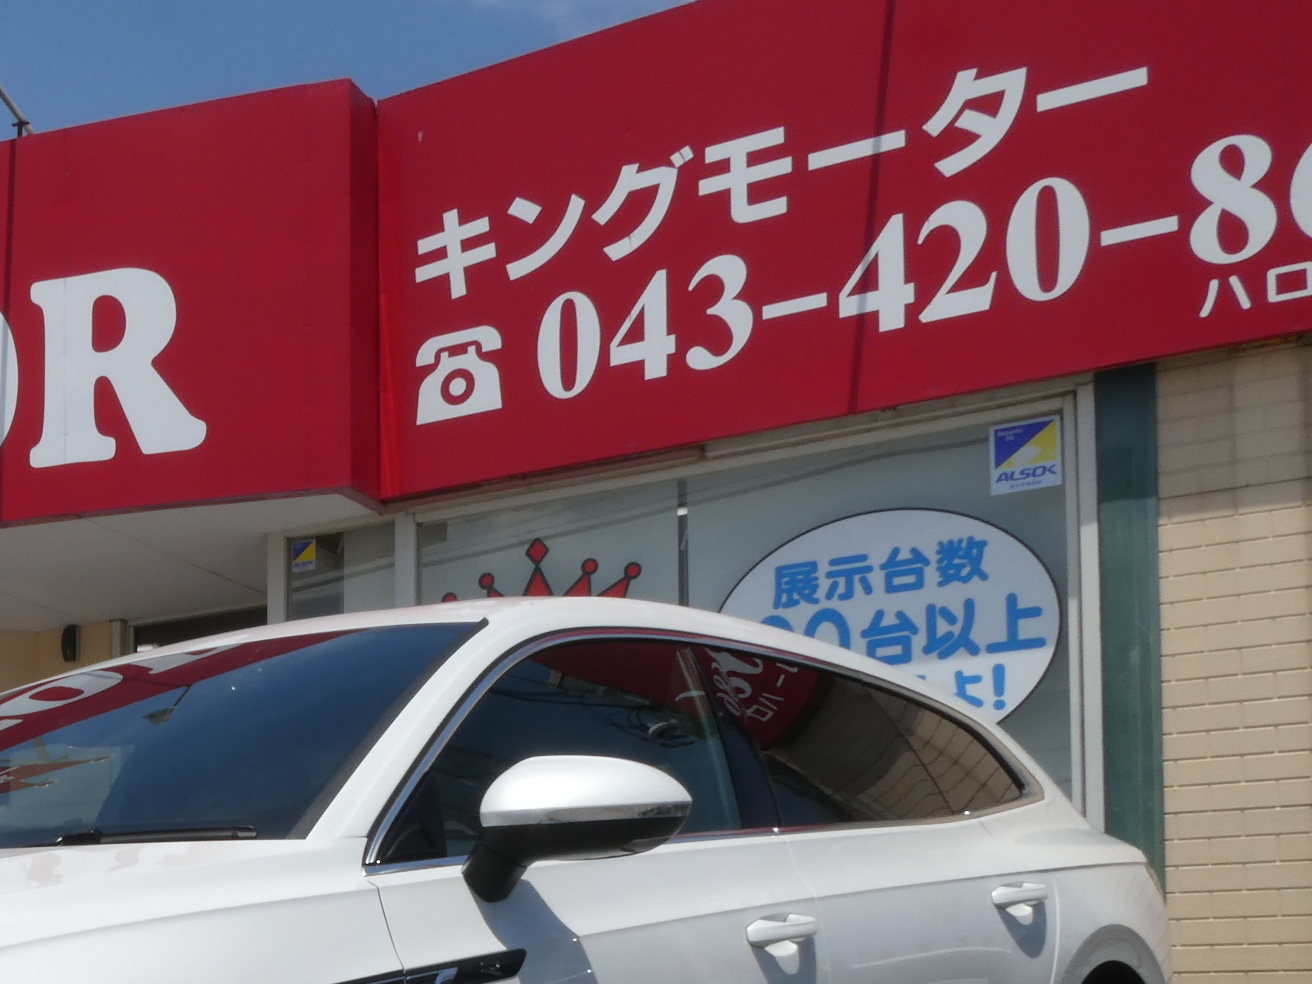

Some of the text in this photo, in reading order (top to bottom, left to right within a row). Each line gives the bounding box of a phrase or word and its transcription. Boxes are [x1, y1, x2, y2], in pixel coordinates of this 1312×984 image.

[415, 66, 1148, 299] キングモーター
[537, 134, 1312, 399] 043-420-8
[996, 463, 1058, 484] ALSOK
[773, 536, 989, 609] 展示台数
[760, 592, 1046, 666] 0台以上
